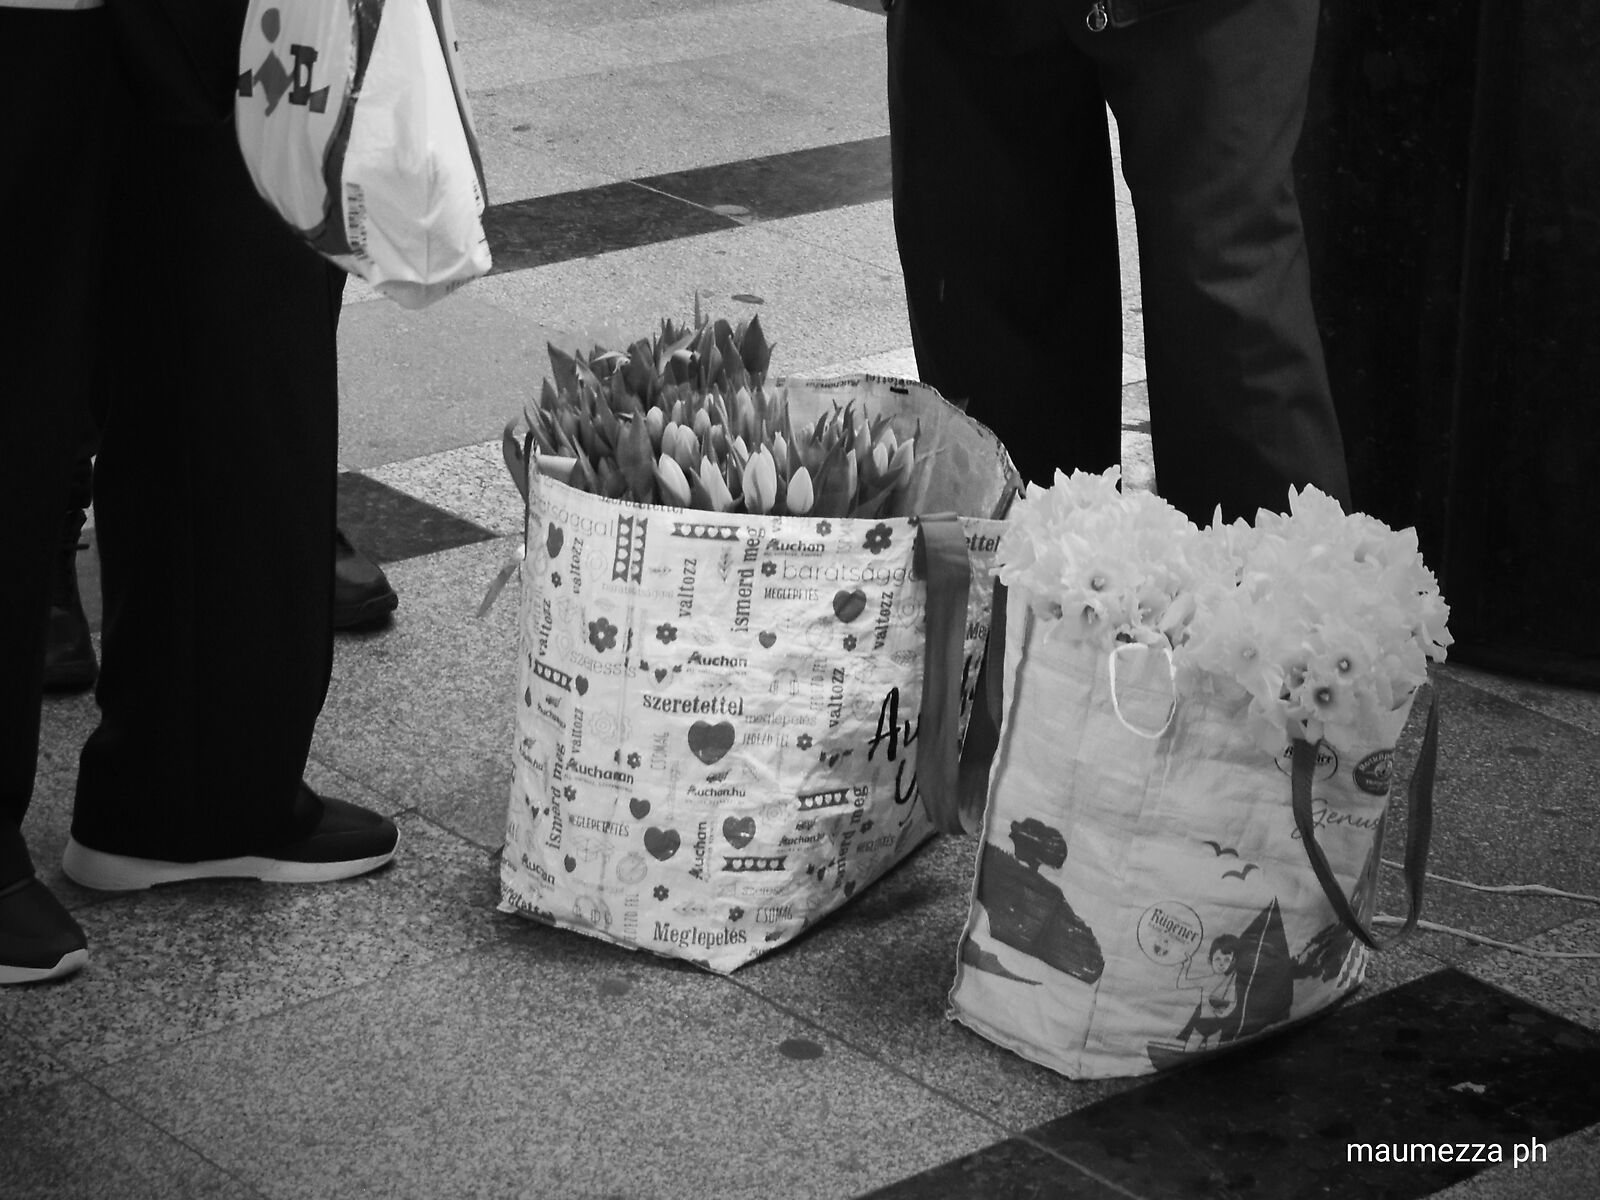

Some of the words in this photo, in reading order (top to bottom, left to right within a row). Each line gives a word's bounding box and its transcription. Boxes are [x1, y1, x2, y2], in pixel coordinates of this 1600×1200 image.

[766, 538, 825, 552] Auchan
[687, 651, 747, 667] Auchan
[643, 693, 744, 717] szeretettel
